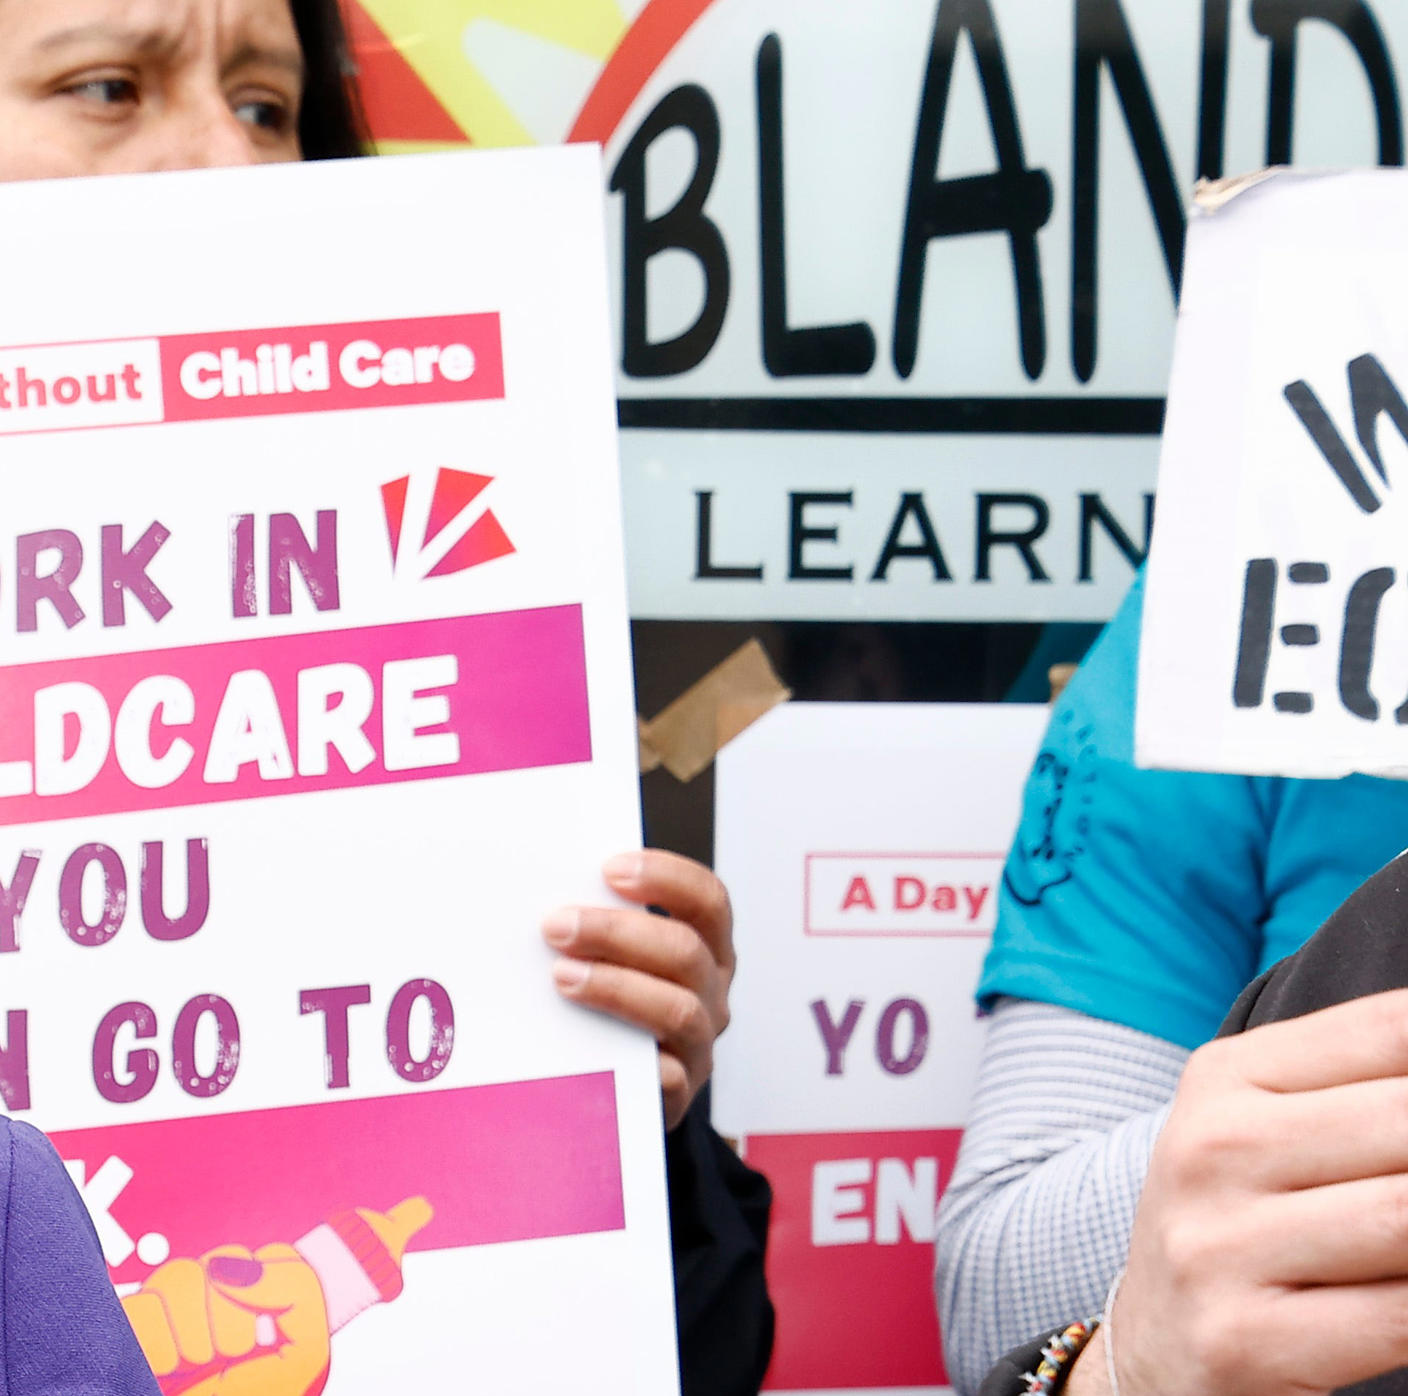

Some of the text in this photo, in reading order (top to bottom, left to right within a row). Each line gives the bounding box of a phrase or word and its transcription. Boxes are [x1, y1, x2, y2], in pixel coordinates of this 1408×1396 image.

[179, 341, 330, 400] Child
[338, 340, 475, 389] Care
[230, 508, 341, 620] IN
[839, 874, 991, 923] A Day
[90, 992, 242, 1105] GO
[297, 977, 456, 1091] TO
[810, 998, 930, 1077] YO
